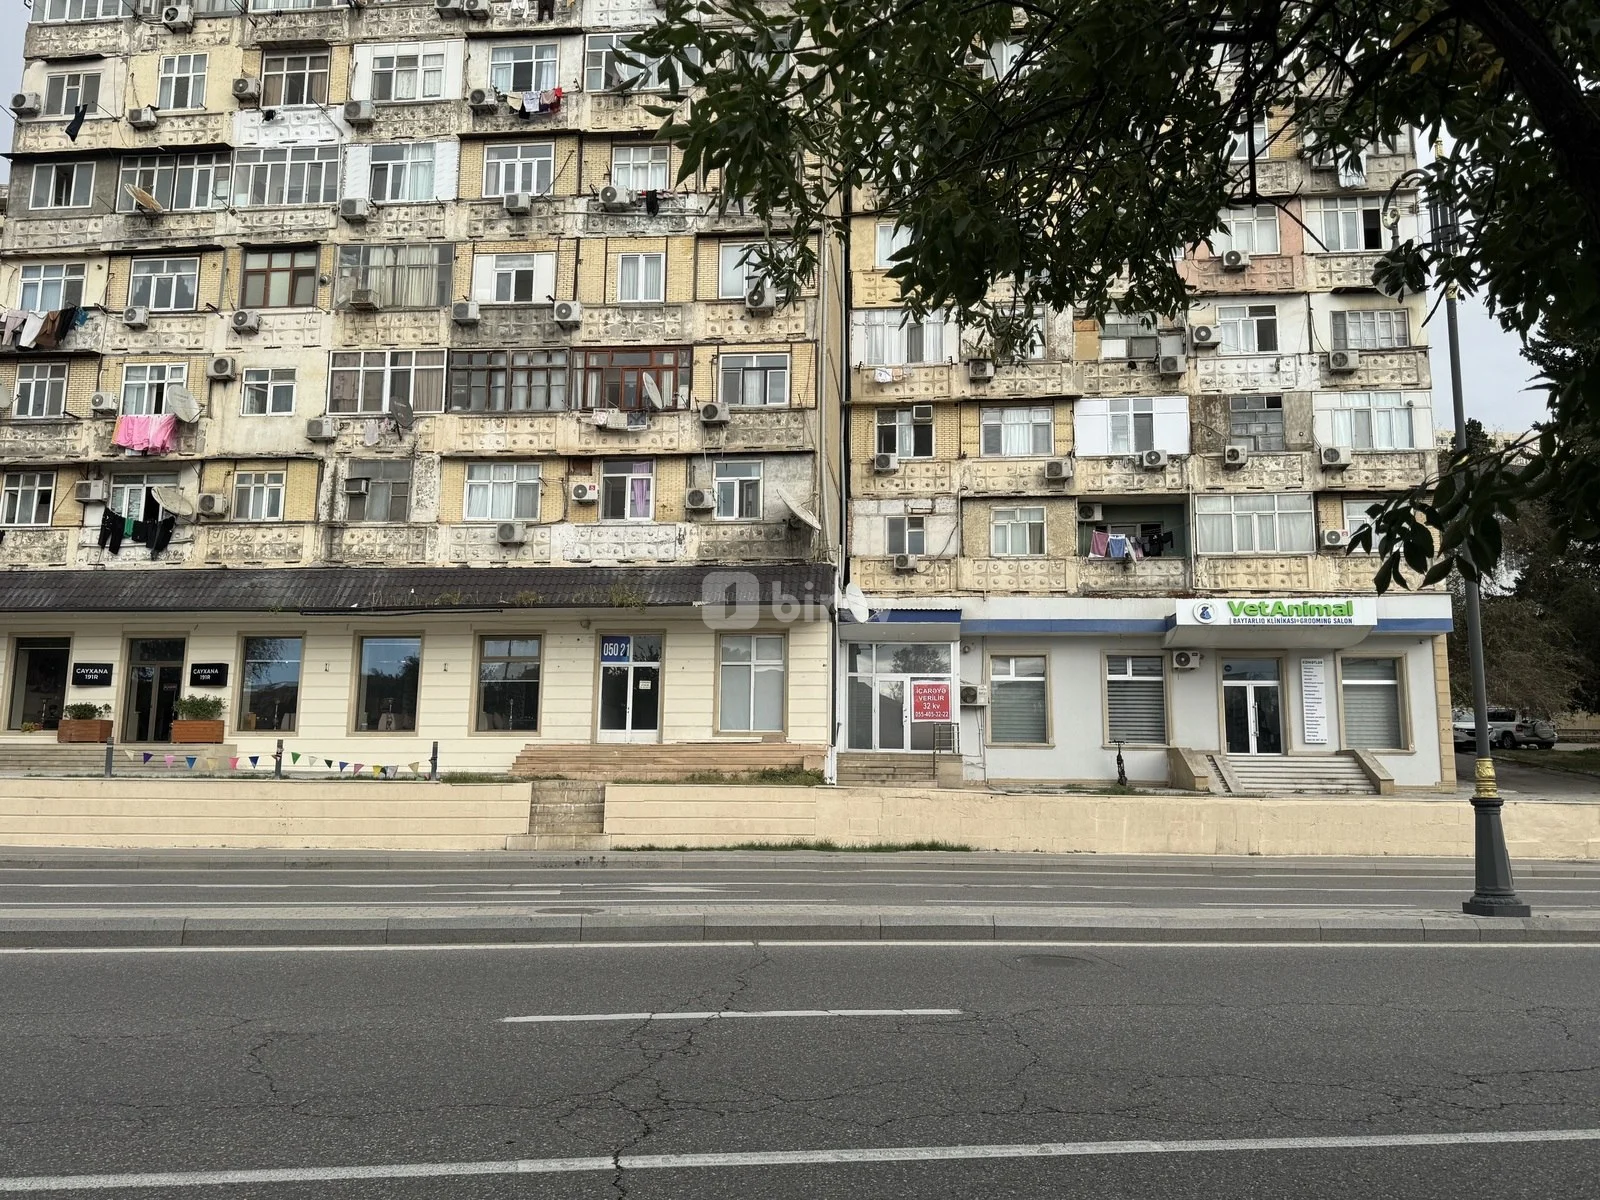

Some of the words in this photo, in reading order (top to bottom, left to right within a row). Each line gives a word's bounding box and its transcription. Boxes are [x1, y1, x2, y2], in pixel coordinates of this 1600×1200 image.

[1227, 600, 1354, 617] VetAnimal
[603, 643, 619, 656] 050
[922, 702, 931, 710] 32
[932, 702, 941, 710] kv
